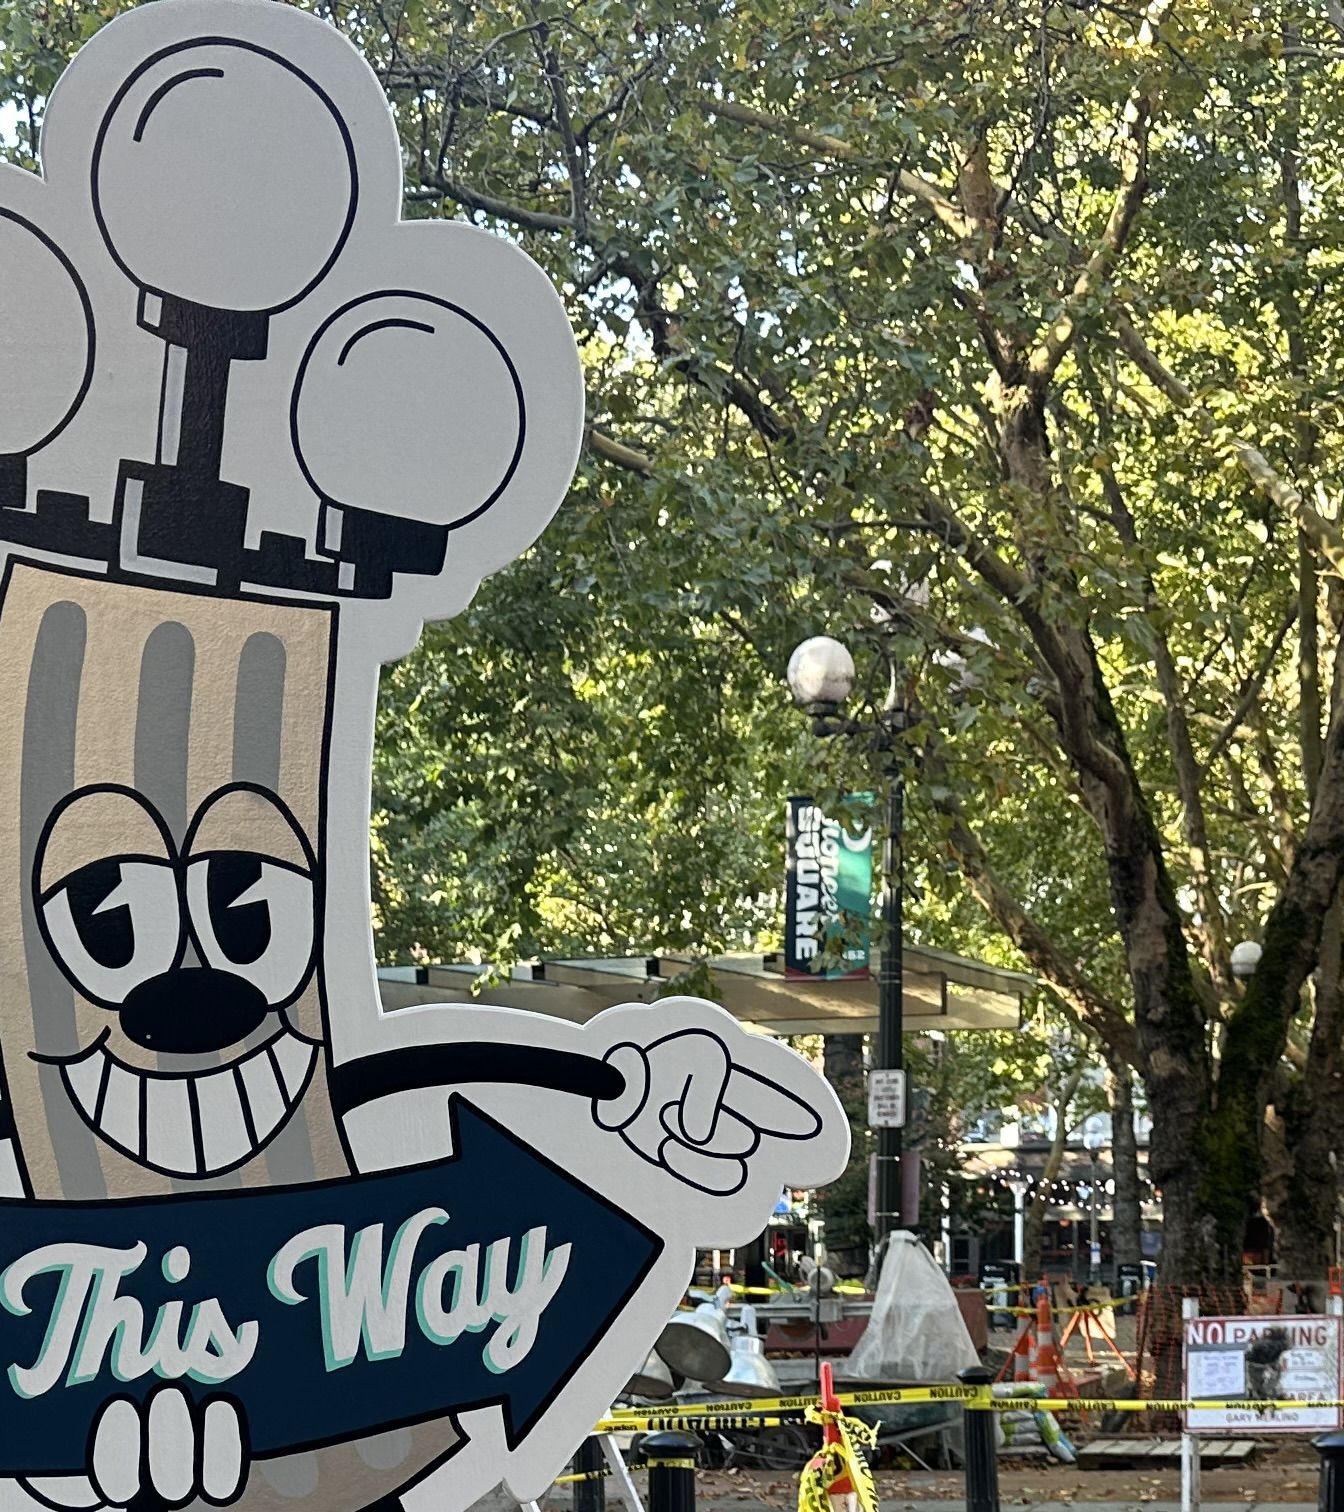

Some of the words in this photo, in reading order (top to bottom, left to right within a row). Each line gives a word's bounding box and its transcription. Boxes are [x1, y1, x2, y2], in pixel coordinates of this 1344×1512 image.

[795, 806, 822, 961] SQUARE
[267, 1206, 573, 1375] Way
[1188, 1322, 1223, 1344] NO
[854, 1391, 901, 1403] CAUTION
[930, 1386, 978, 1399] CAUTION
[706, 1401, 753, 1413] CAUTION
